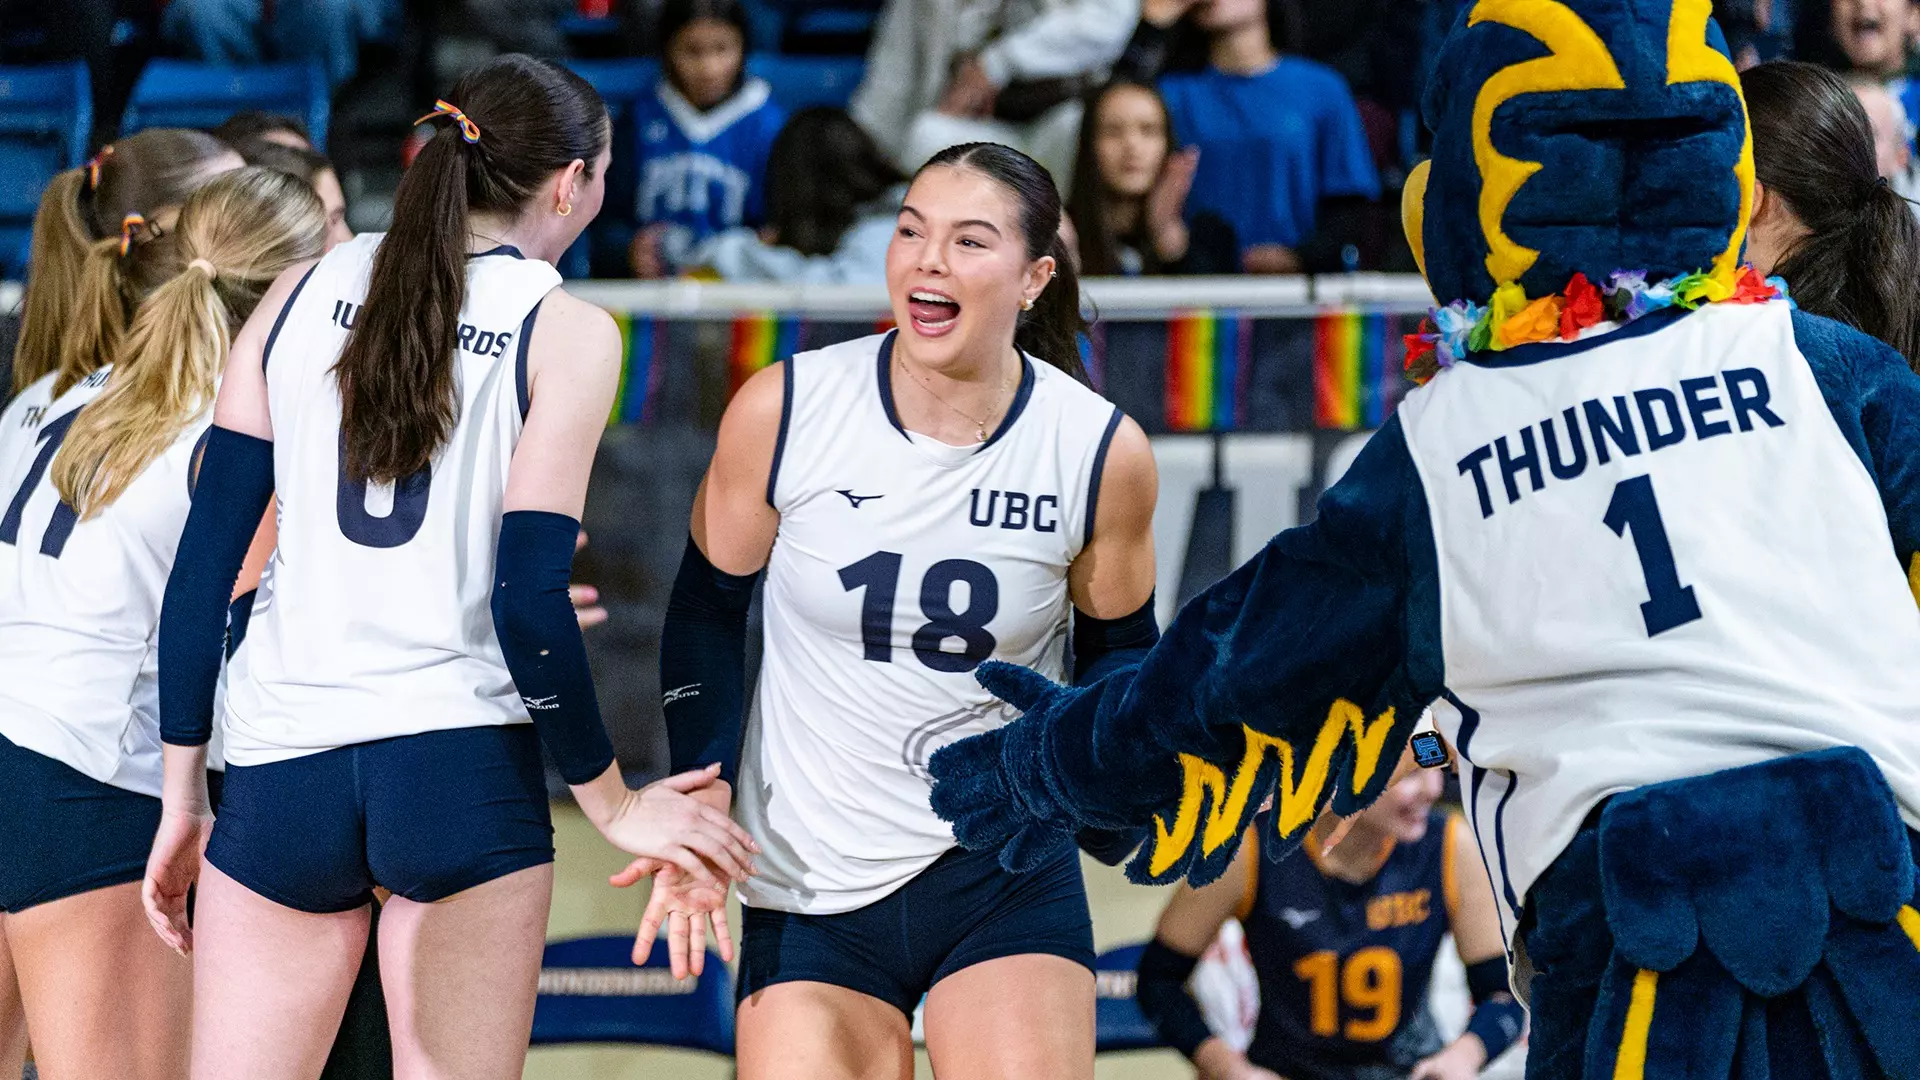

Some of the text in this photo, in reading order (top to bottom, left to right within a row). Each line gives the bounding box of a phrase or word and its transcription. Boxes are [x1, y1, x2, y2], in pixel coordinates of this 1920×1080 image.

[1457, 367, 1786, 519] THUNDER
[969, 488, 1058, 533] UBC
[1602, 473, 1703, 639] 1
[837, 550, 999, 673] 18
[1293, 946, 1404, 1042] 19
